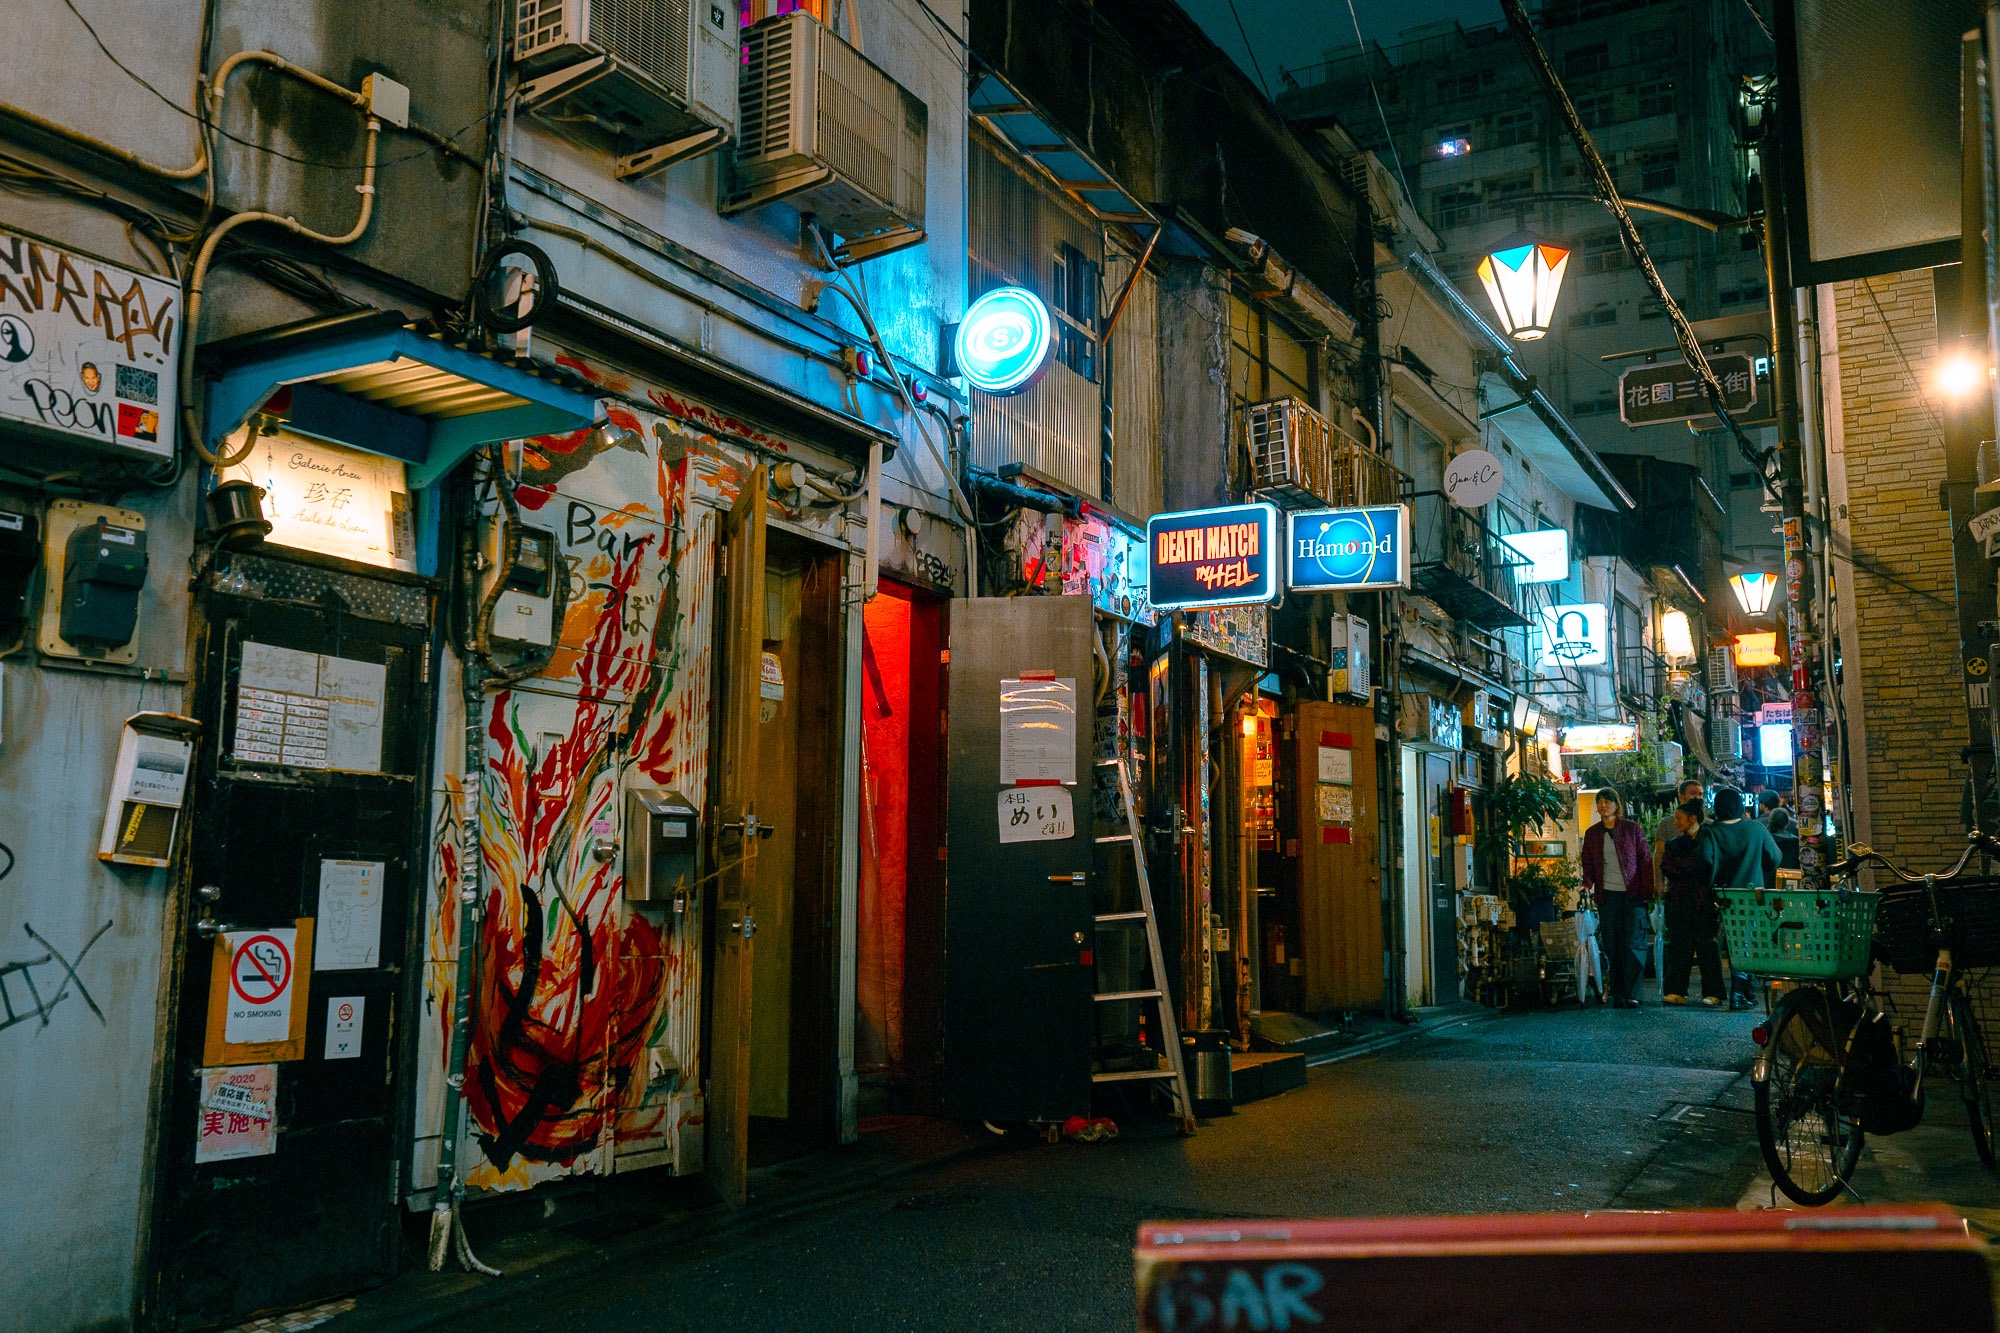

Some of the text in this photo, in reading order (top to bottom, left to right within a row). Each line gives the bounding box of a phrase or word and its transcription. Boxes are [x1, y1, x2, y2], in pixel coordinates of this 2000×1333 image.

[288, 453, 331, 473] Galerie
[1473, 471, 1479, 486] &
[566, 501, 655, 562] Bar
[1158, 522, 1259, 565] DEATH MATCH
[1204, 558, 1260, 591] HELL
[1010, 803, 1058, 826] めい
[233, 1009, 282, 1019] NO SMOKING
[230, 1073, 256, 1085] 2020
